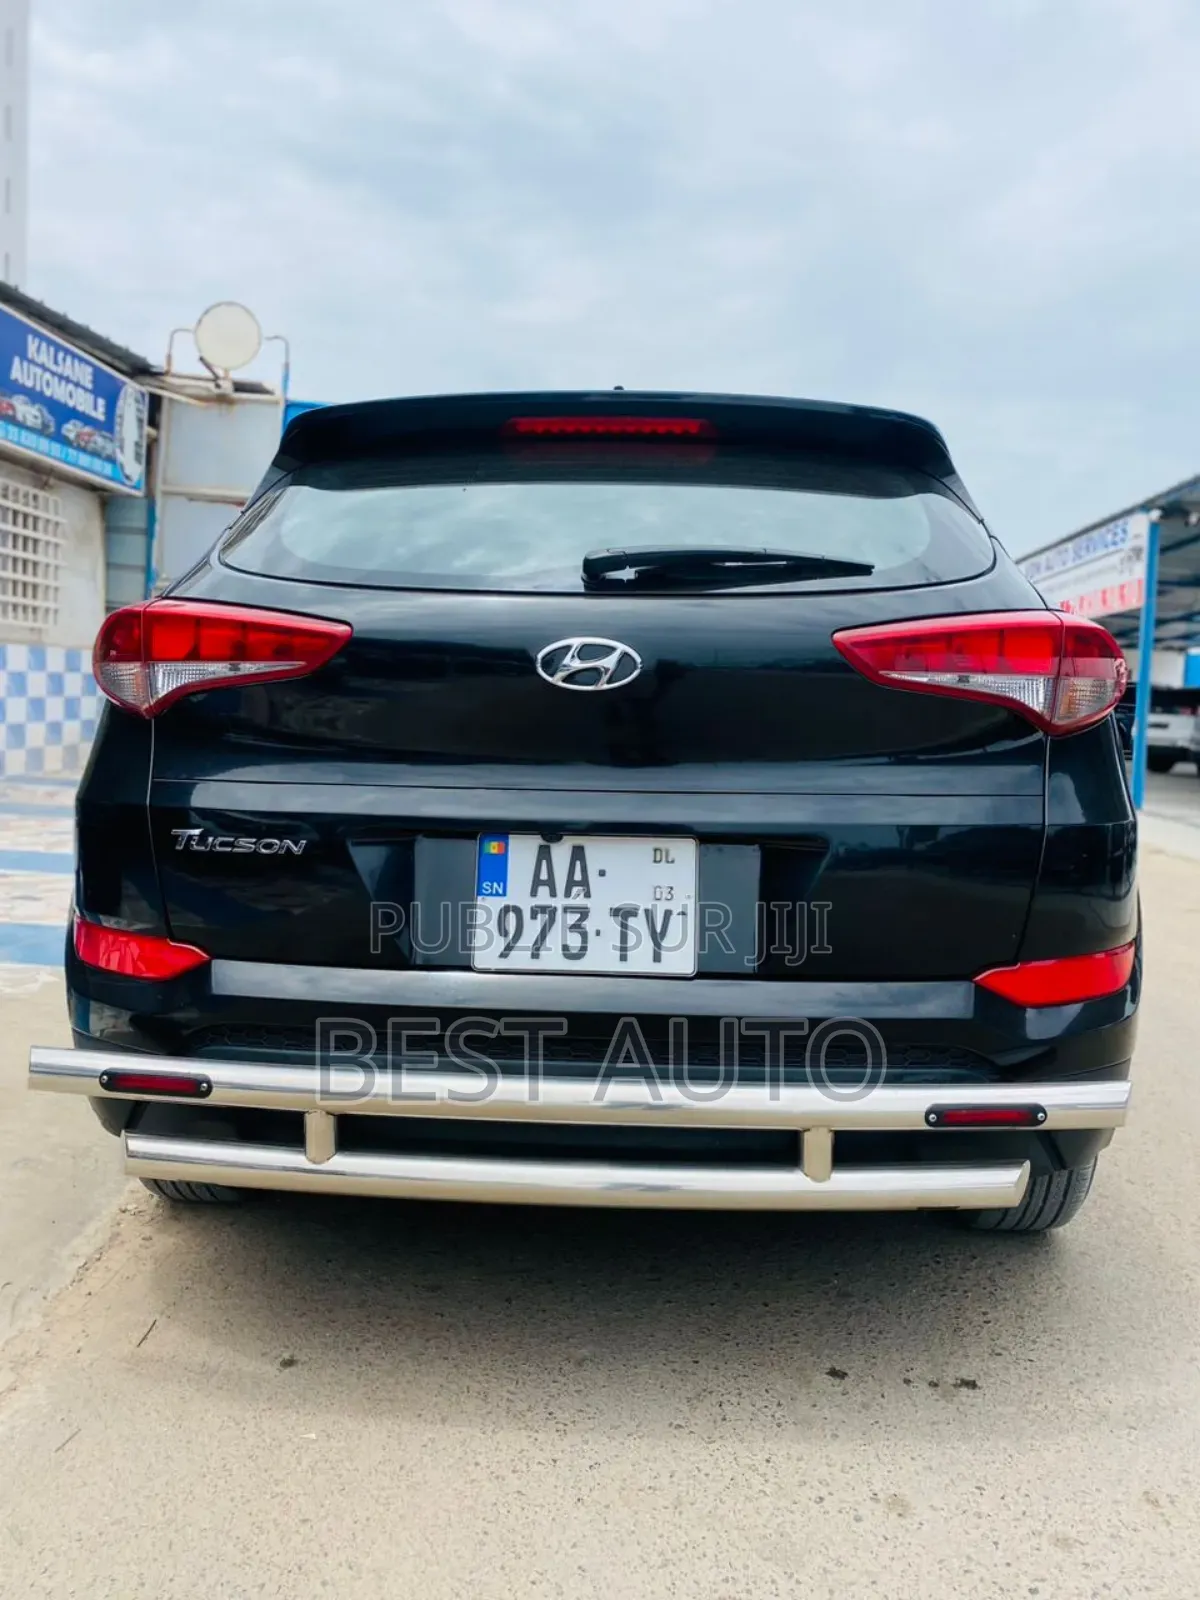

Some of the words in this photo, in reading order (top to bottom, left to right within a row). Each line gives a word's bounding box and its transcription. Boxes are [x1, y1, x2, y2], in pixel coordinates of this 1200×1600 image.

[27, 334, 94, 389] KALSANE
[10, 355, 107, 422] AUTOMOBILE
[652, 847, 676, 864] DL
[482, 881, 504, 895] SN
